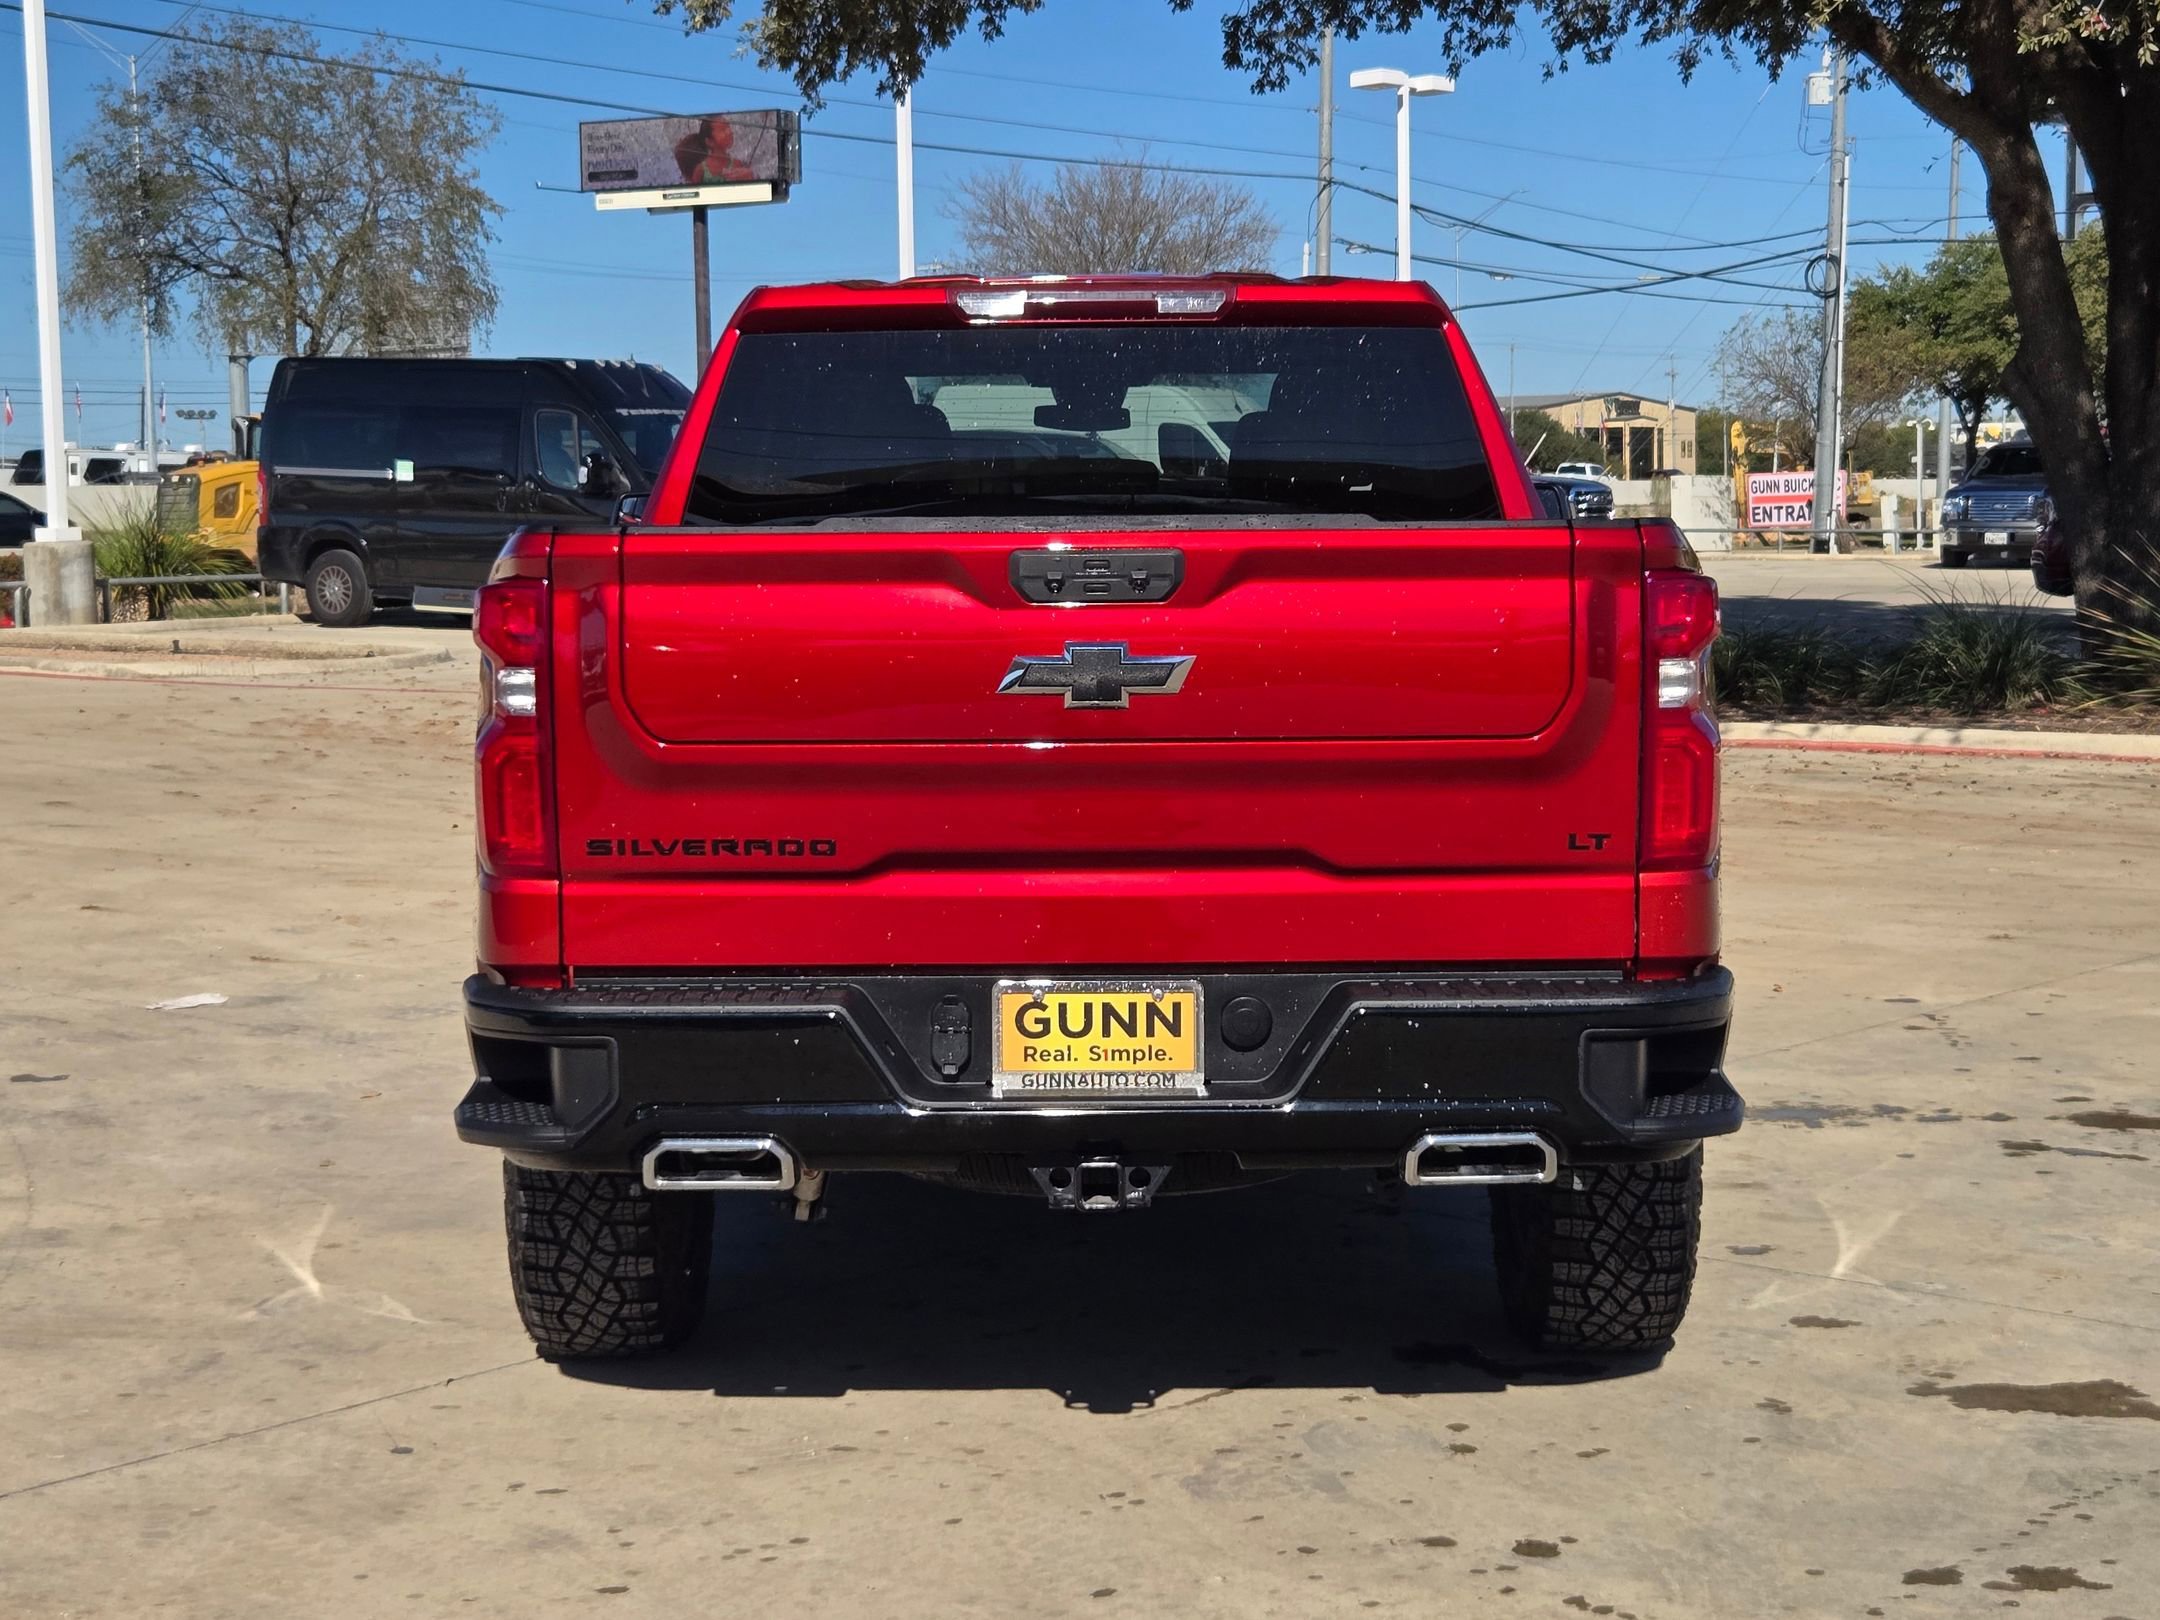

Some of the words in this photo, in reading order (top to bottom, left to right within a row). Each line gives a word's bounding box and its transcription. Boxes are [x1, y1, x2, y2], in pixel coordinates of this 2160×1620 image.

[1751, 480, 1780, 494] GUNN
[1784, 478, 1815, 492] BUICK
[1752, 504, 1841, 522] ENTRA
[586, 839, 837, 856] SILVERADO
[1568, 833, 1611, 850] LT
[1015, 1001, 1182, 1039] GUNN
[1023, 1045, 1078, 1062] Real.
